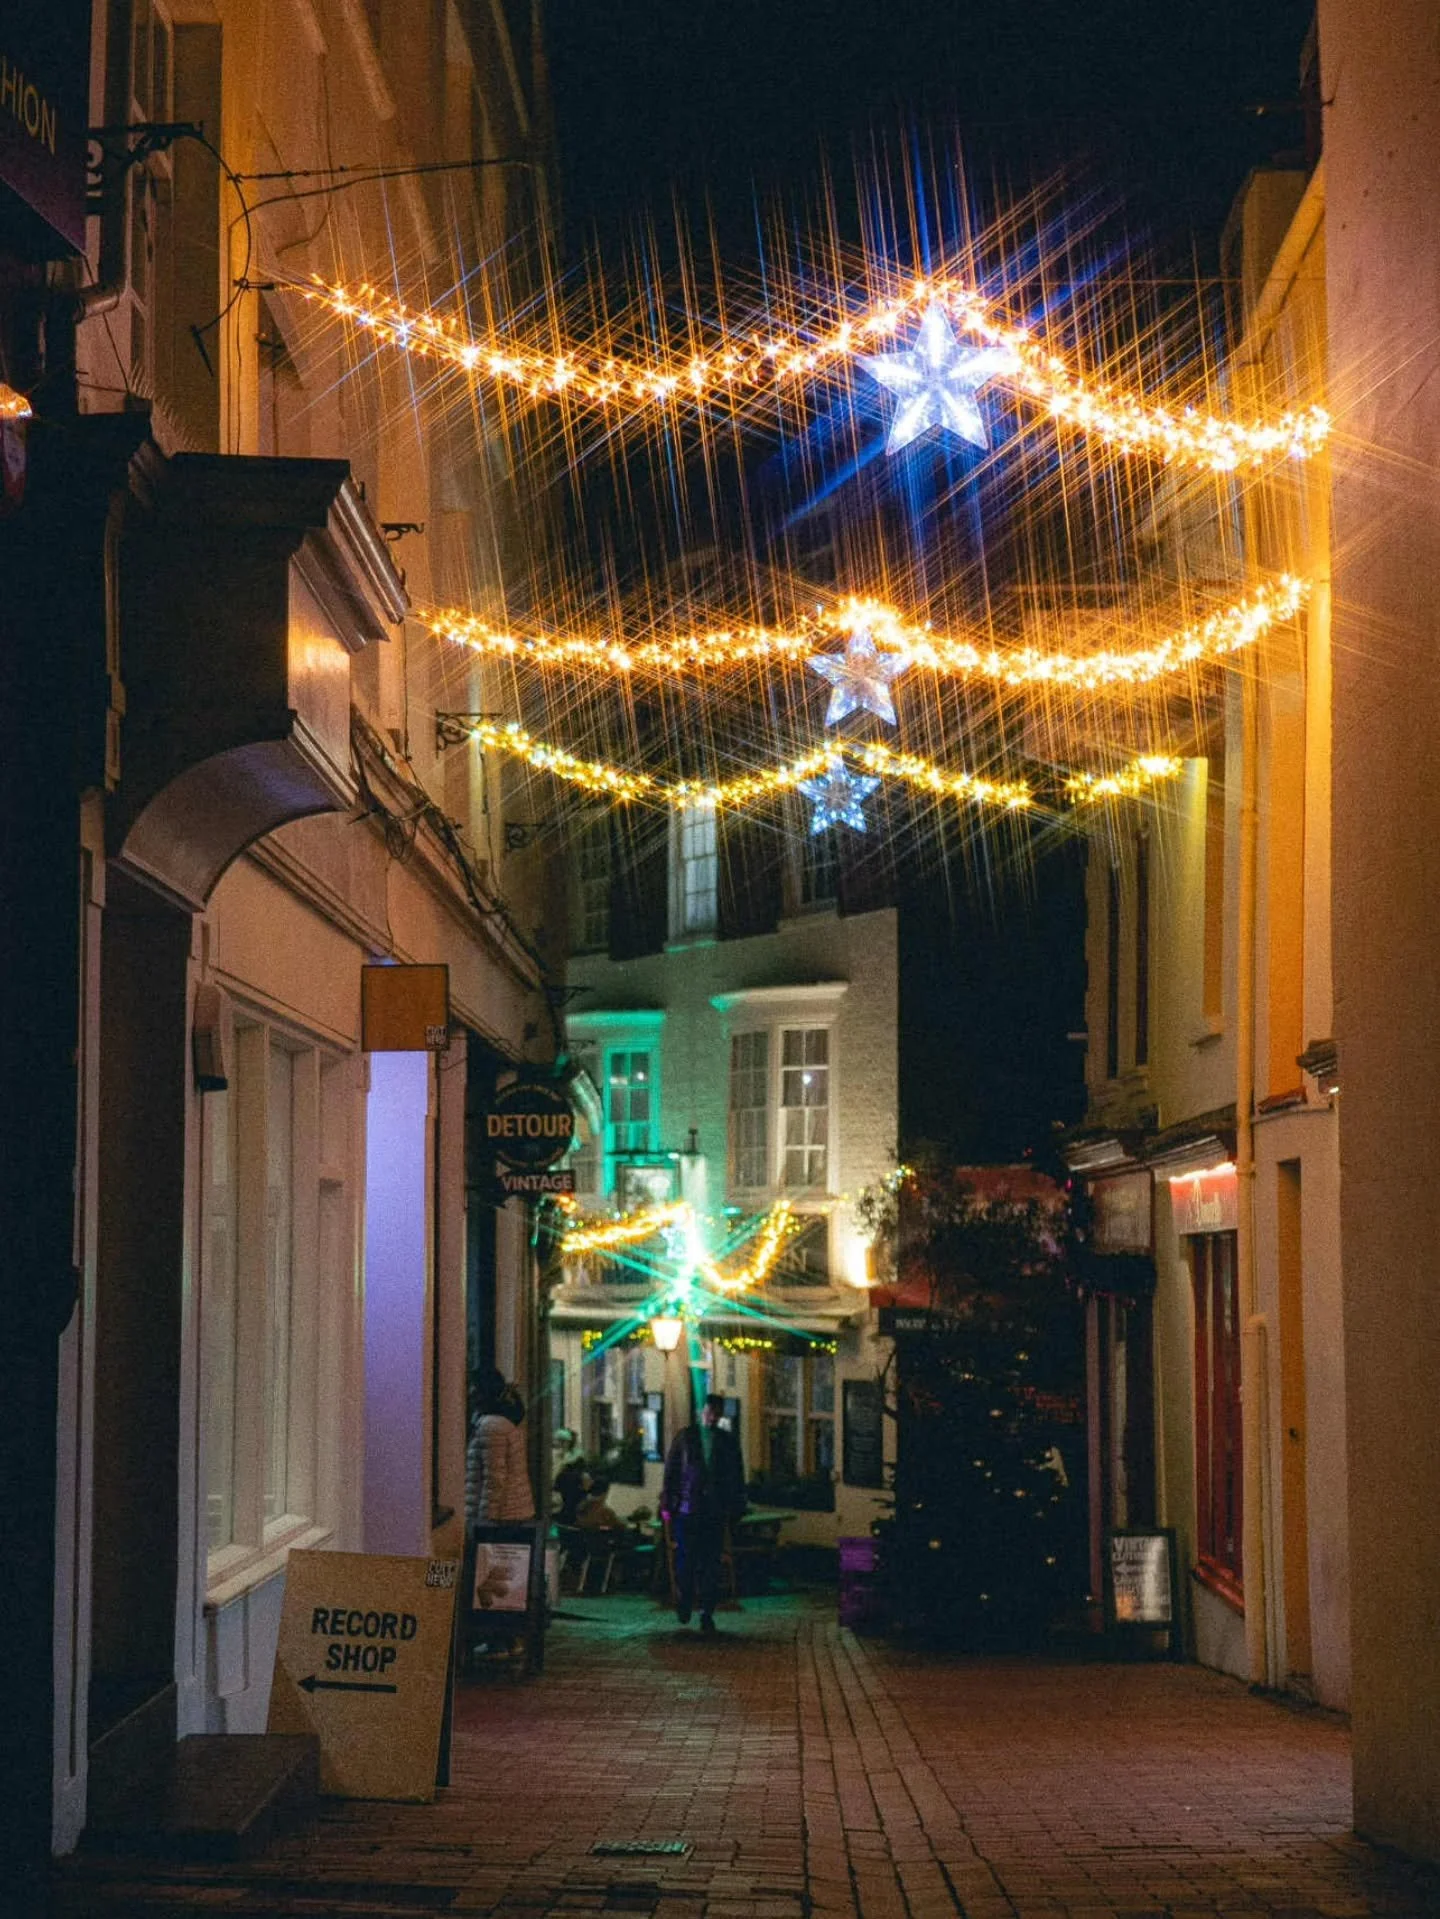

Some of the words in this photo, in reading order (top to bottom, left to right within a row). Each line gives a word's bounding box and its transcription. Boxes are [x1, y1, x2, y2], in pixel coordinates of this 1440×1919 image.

[0, 55, 57, 156] HION
[487, 1113, 571, 1138] DETOUR
[502, 1173, 572, 1193] VINTAGE
[311, 1607, 417, 1641] RECORD
[325, 1643, 398, 1673] SHOP
